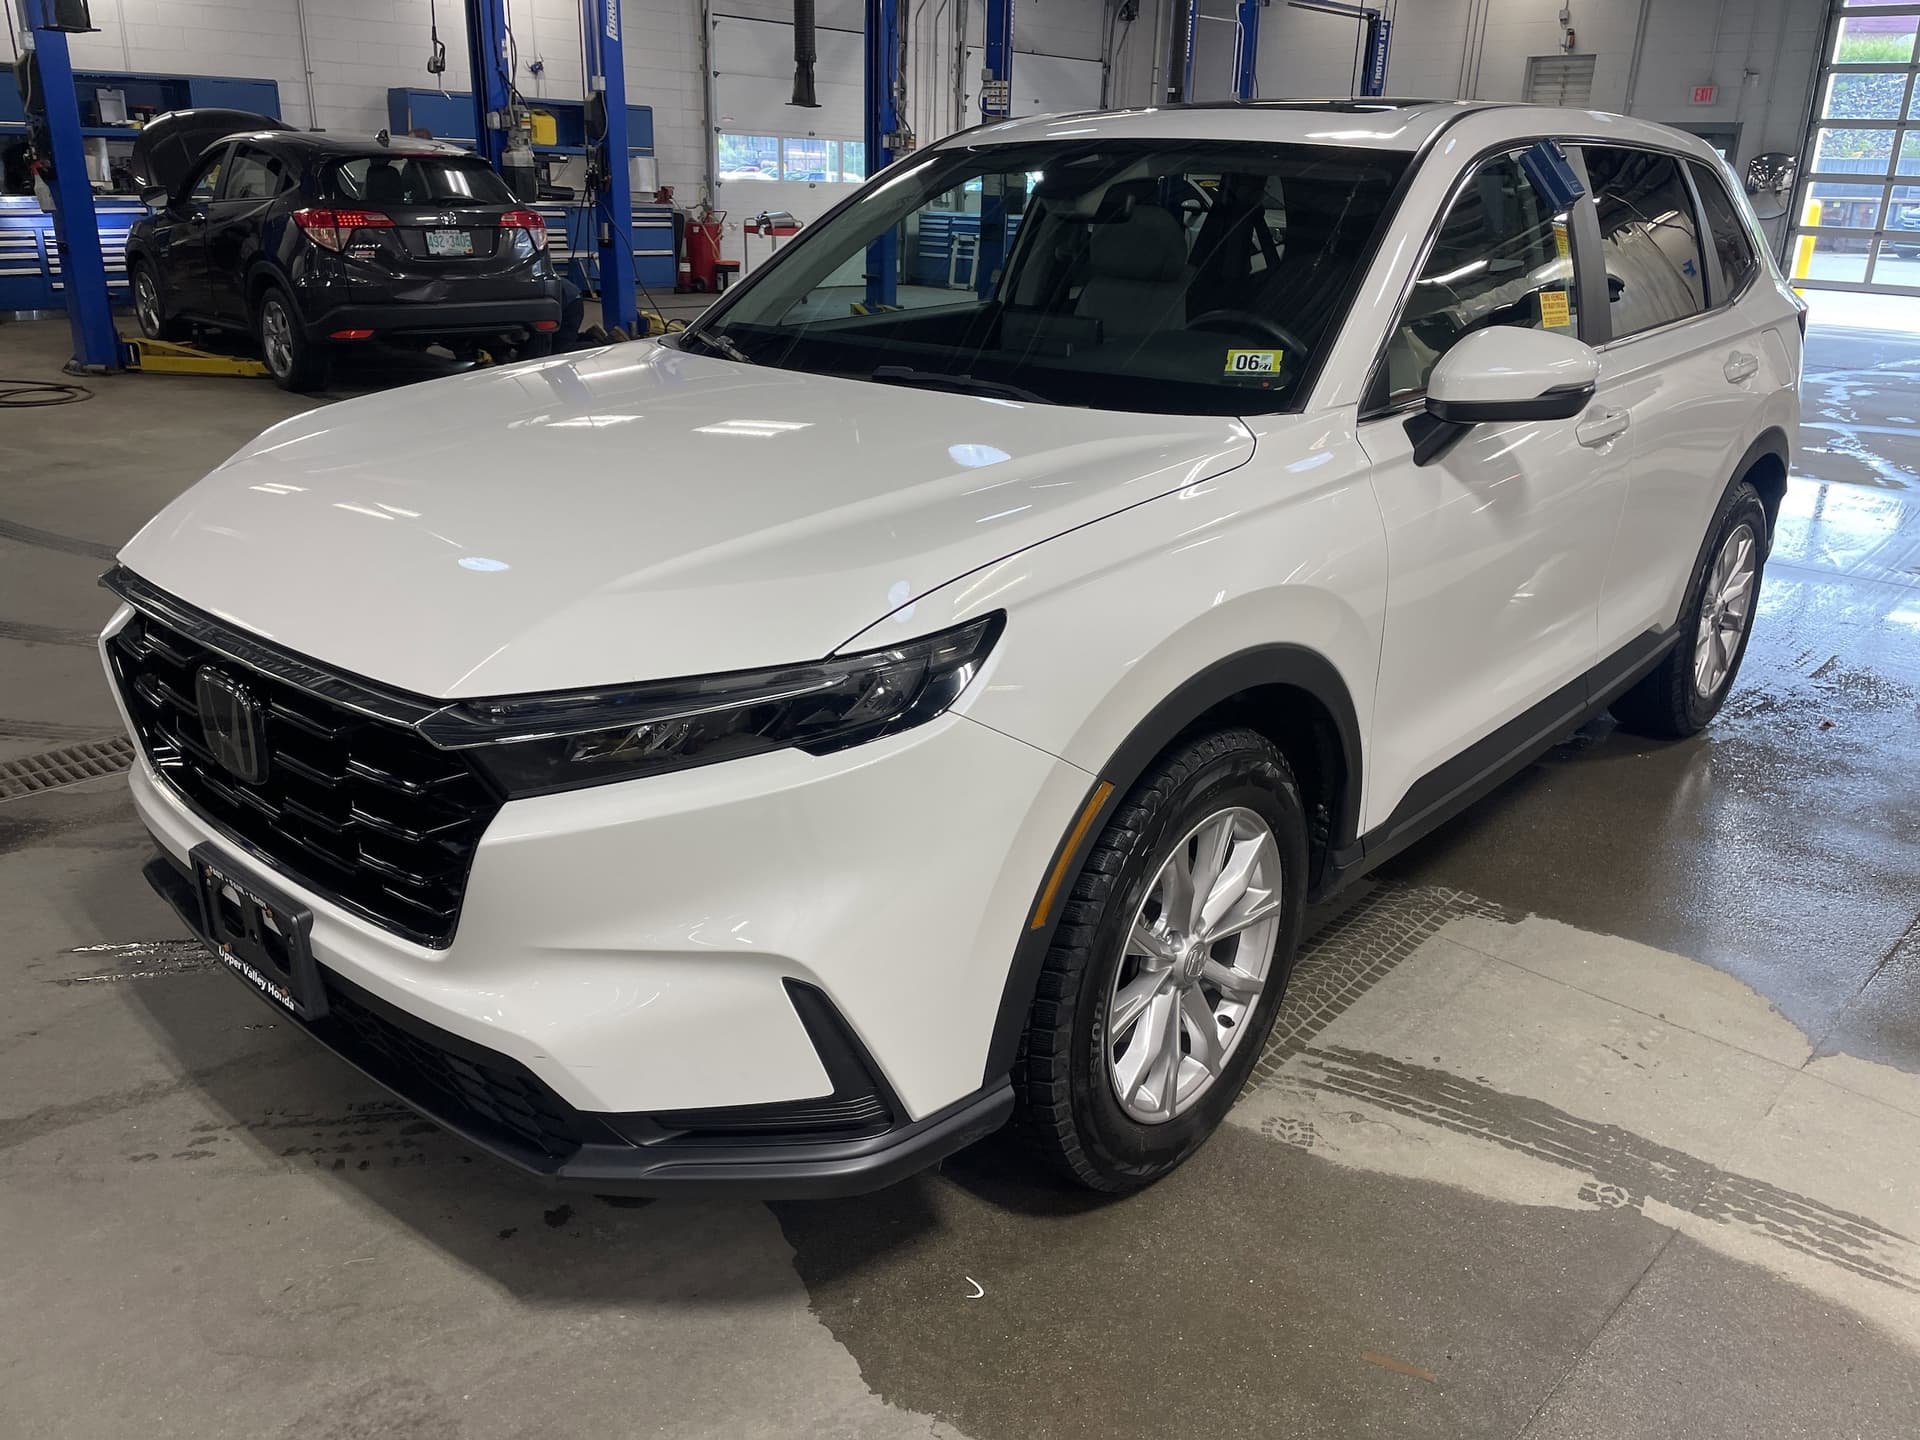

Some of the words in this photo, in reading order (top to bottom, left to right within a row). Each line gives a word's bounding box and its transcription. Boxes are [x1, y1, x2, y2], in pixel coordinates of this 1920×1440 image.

[1379, 21, 1388, 41] LIFT
[1374, 42, 1385, 80] ROTARY
[1694, 87, 1713, 103] EXIT
[1236, 354, 1260, 370] 06
[218, 945, 242, 970] Upper
[243, 963, 267, 991] Valley
[267, 982, 295, 1012] Honda
